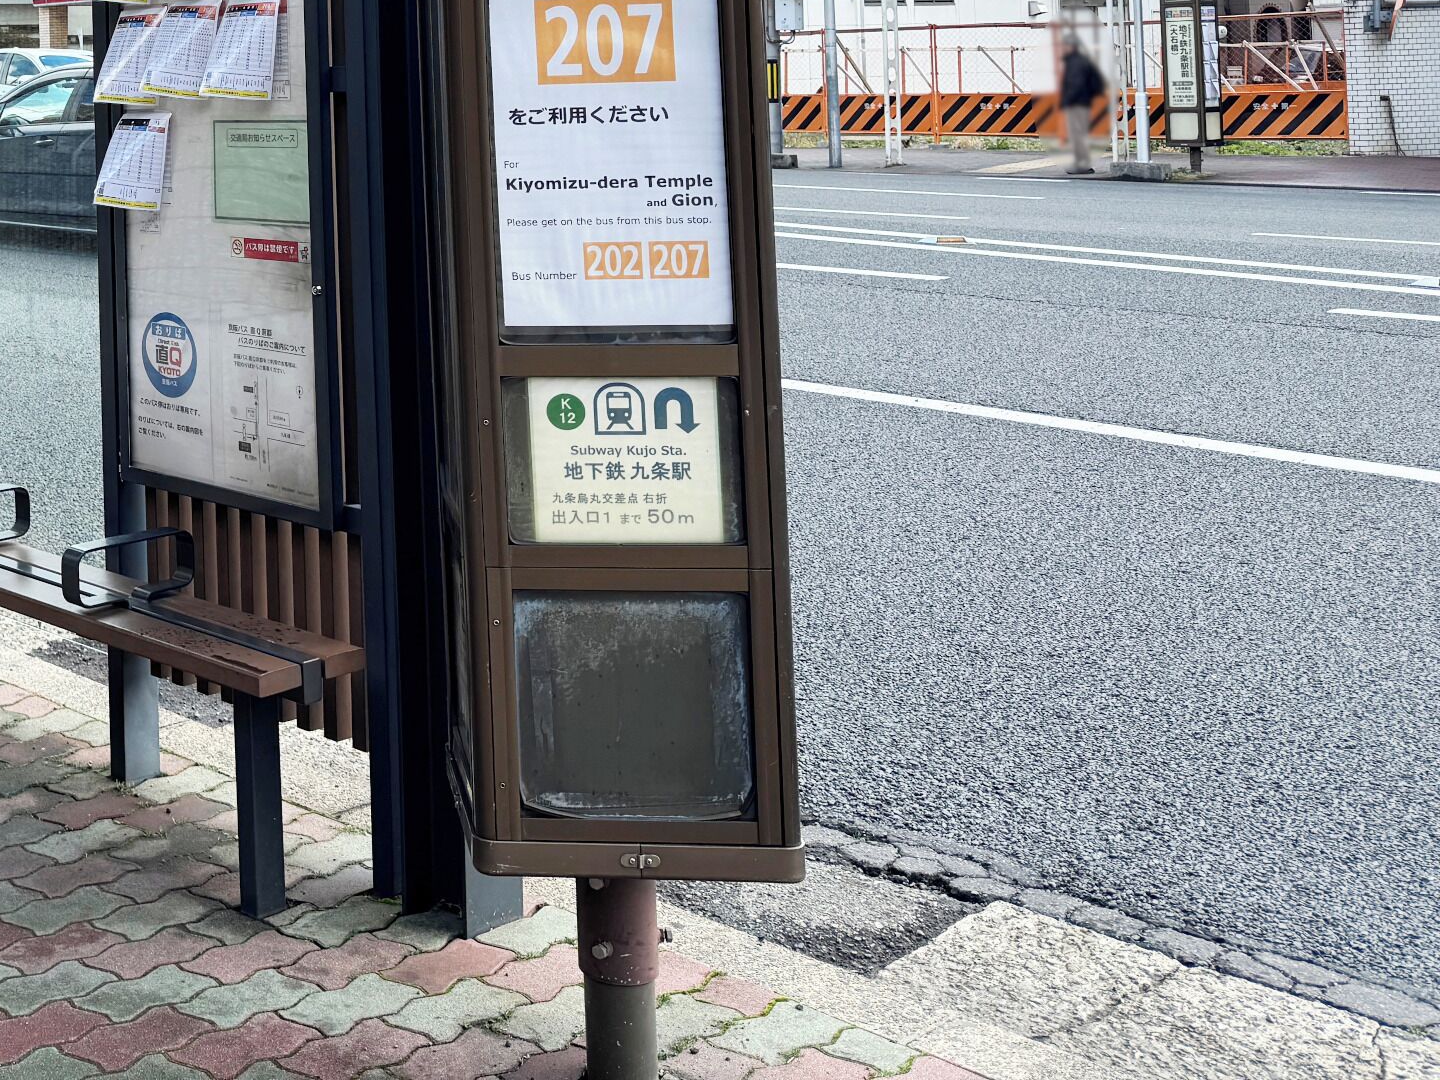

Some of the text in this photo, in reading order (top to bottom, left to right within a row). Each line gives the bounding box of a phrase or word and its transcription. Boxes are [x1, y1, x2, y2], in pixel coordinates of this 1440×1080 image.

[545, 3, 663, 77] 207
[1179, 24, 1190, 78] 地下鉄九条駅前
[508, 105, 669, 126] をご利用ください
[504, 160, 520, 169] For
[505, 173, 713, 193] Kiyomizu-dera Temple
[646, 193, 718, 208] and Gion,
[507, 215, 712, 228] Please get on the bus from this bus stop.
[586, 244, 705, 276] 202 207
[511, 270, 578, 281] Bus Number
[155, 325, 182, 339] おりば
[158, 365, 181, 377] KYOTO
[561, 398, 571, 409] K
[559, 413, 576, 424] 12
[570, 445, 687, 458] Subway Kujo Sta.
[564, 461, 692, 481] 地下鉄 九条駅
[642, 492, 668, 504] 右折
[552, 510, 611, 525] 出入口1
[620, 512, 641, 524] まで
